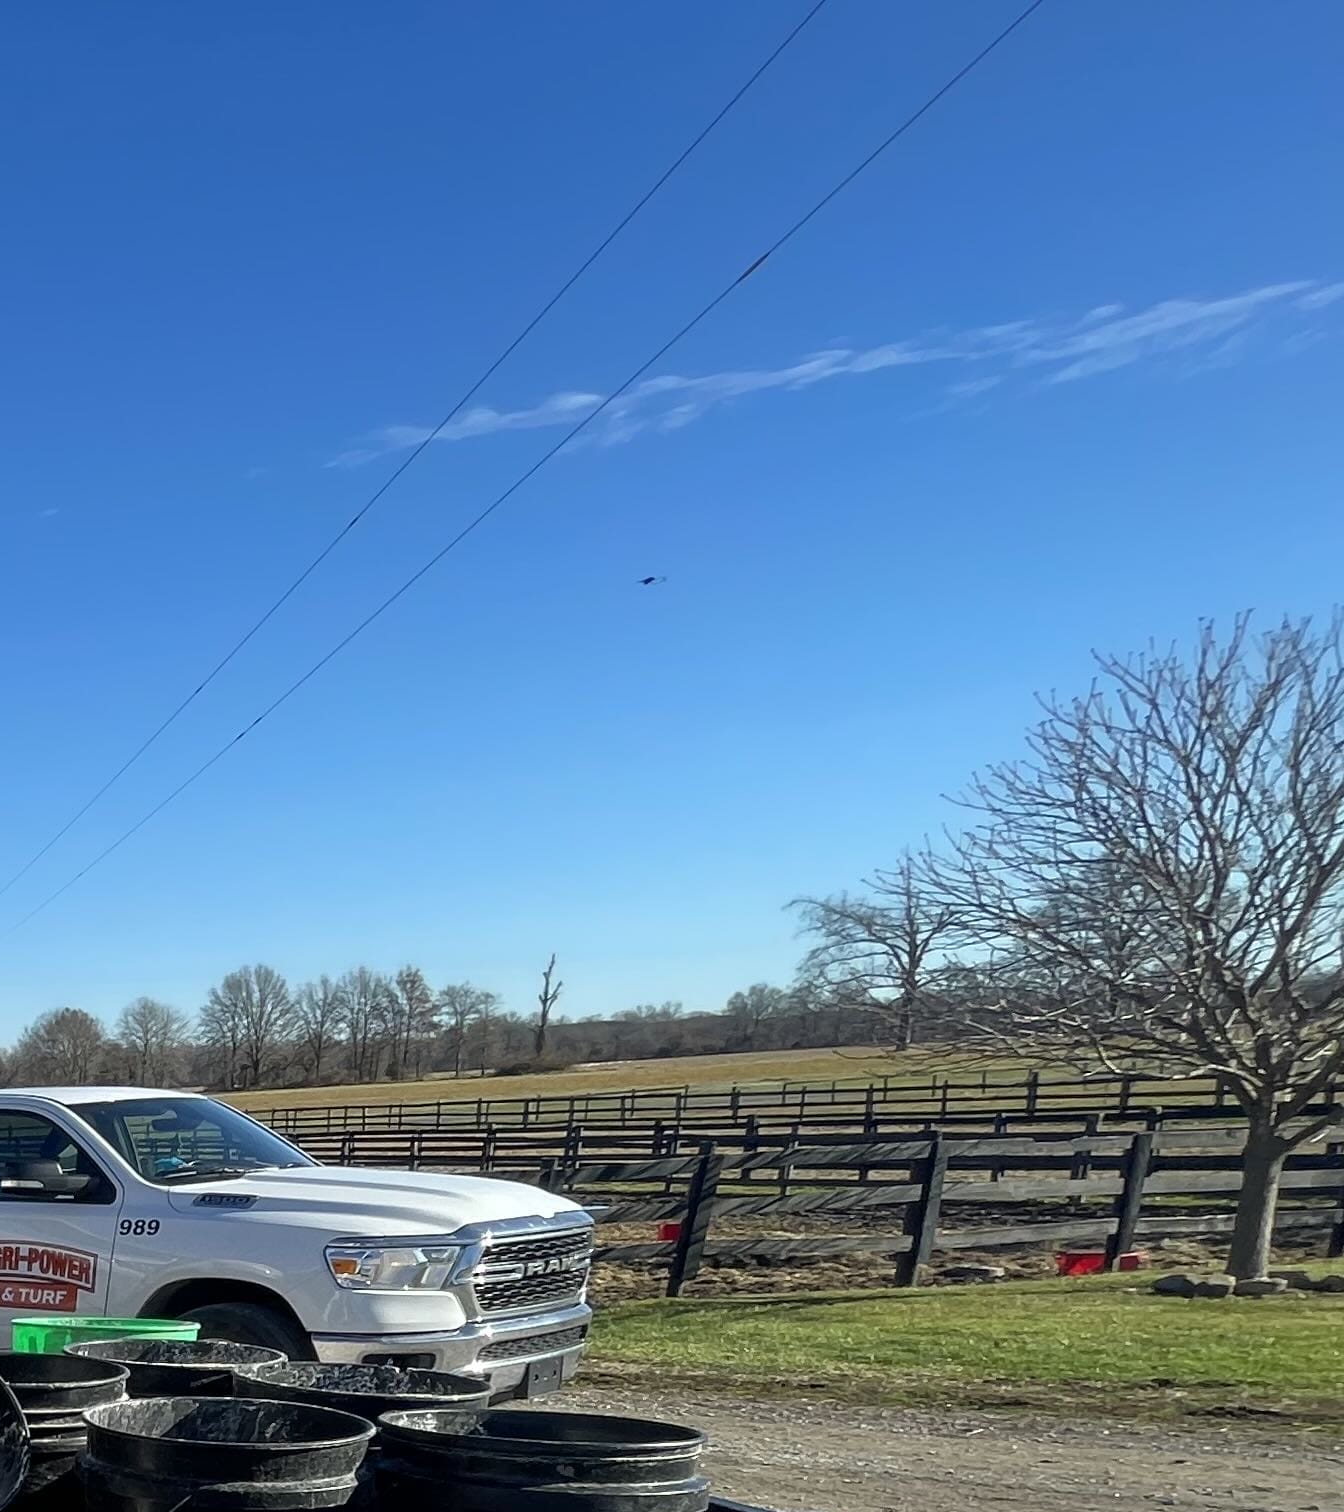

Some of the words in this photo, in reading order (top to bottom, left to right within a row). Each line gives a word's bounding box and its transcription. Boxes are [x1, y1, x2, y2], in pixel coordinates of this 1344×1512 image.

[118, 1218, 161, 1236] 989
[1, 1288, 15, 1302] &
[18, 1287, 68, 1305] TURF
